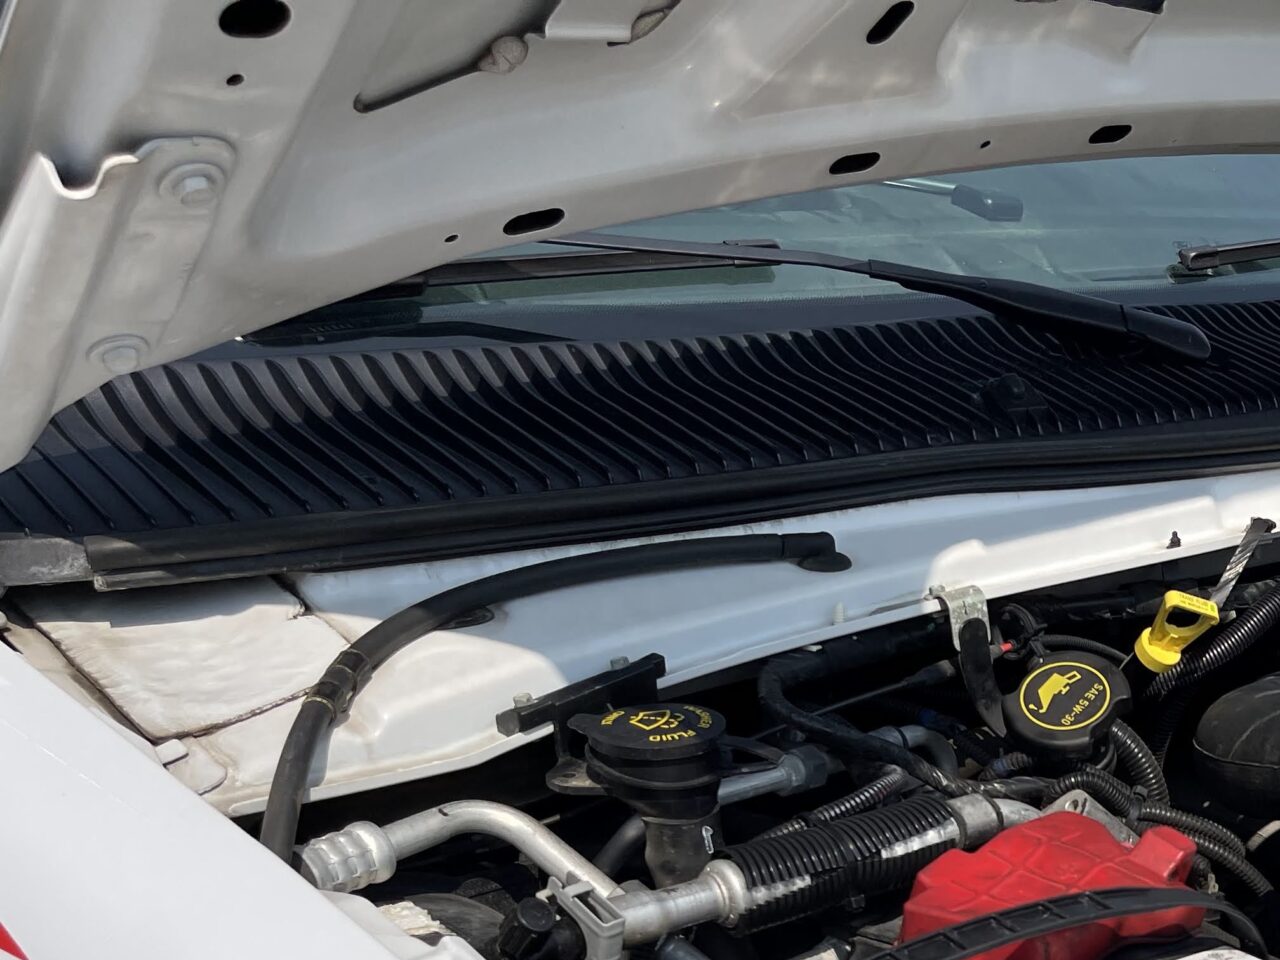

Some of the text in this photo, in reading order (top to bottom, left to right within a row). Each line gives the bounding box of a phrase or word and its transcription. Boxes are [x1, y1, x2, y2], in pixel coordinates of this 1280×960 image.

[1060, 682, 1104, 726] SAE 5W-30
[648, 729, 696, 742] FLUID
